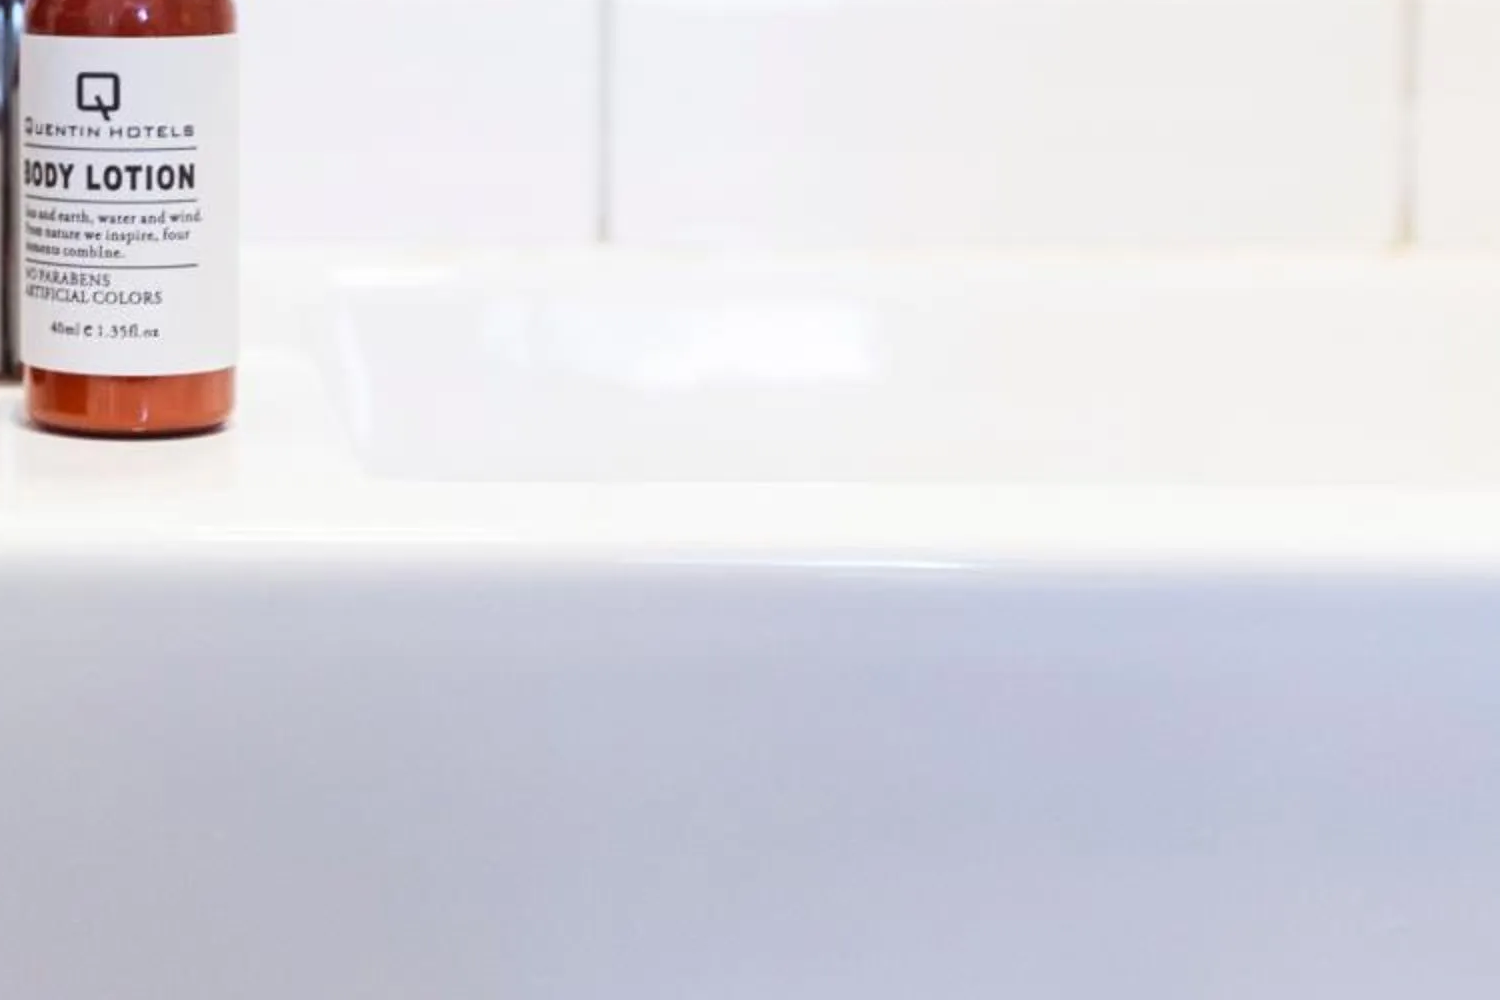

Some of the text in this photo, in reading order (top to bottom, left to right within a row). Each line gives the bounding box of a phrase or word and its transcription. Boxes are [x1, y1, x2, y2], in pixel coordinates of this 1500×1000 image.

[109, 125, 194, 139] HOTELS
[24, 159, 195, 191] BODY LOTION
[98, 214, 136, 225] water
[140, 209, 165, 225] and
[45, 228, 81, 240] nature
[84, 231, 102, 241] we
[162, 226, 190, 241] four
[40, 269, 111, 287] PARABENS
[92, 290, 163, 305] COLORS
